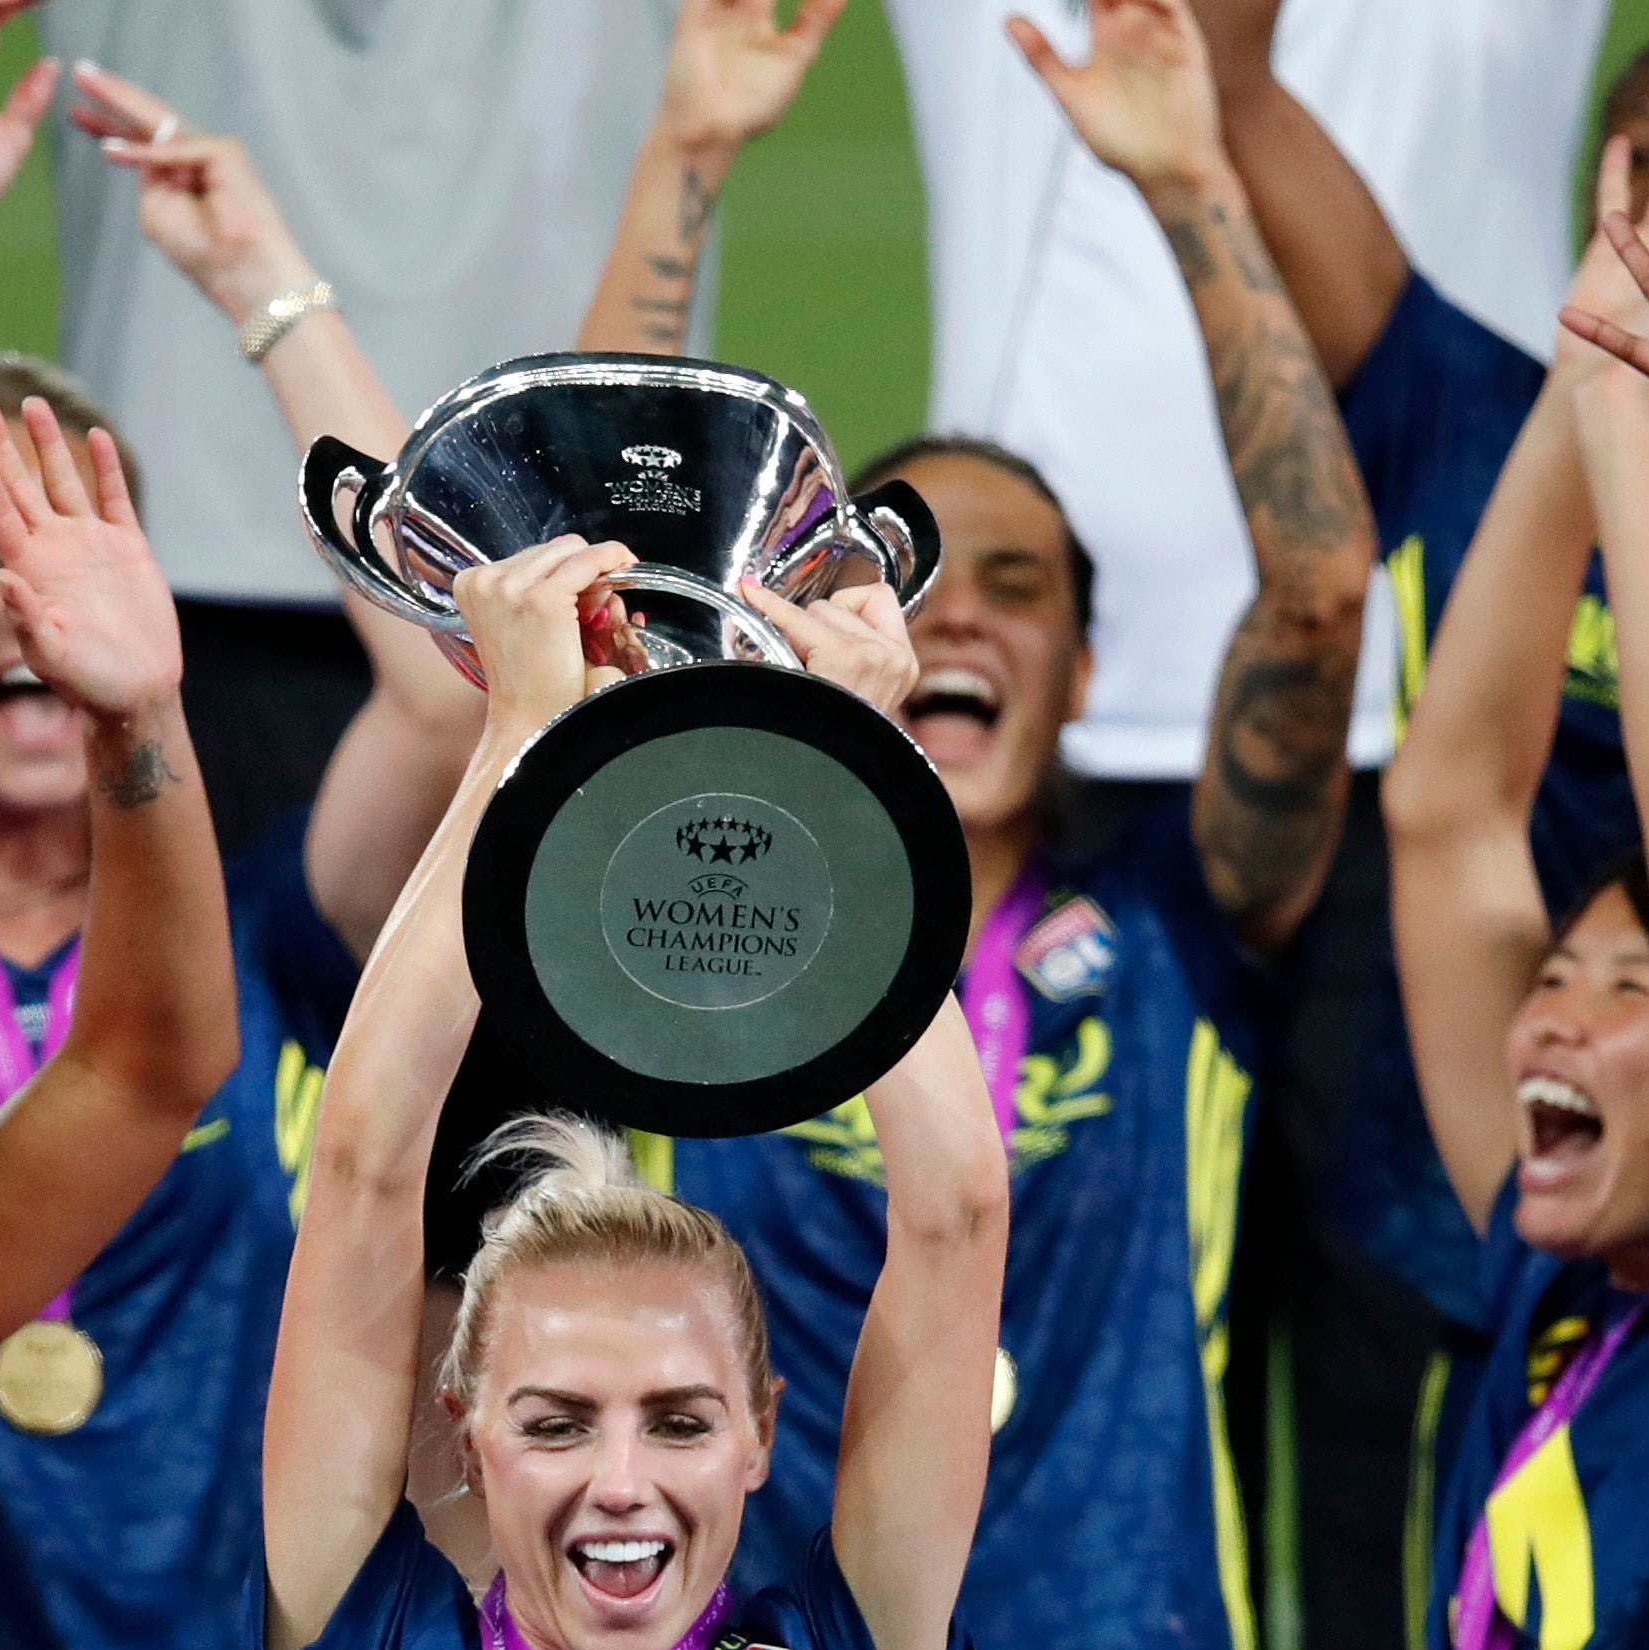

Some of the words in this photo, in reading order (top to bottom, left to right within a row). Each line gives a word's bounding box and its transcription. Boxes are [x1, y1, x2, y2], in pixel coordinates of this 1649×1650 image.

[691, 876, 745, 896] UEFA
[633, 898, 800, 932] WOMEN'S
[626, 926, 798, 957] CHAMPIONS
